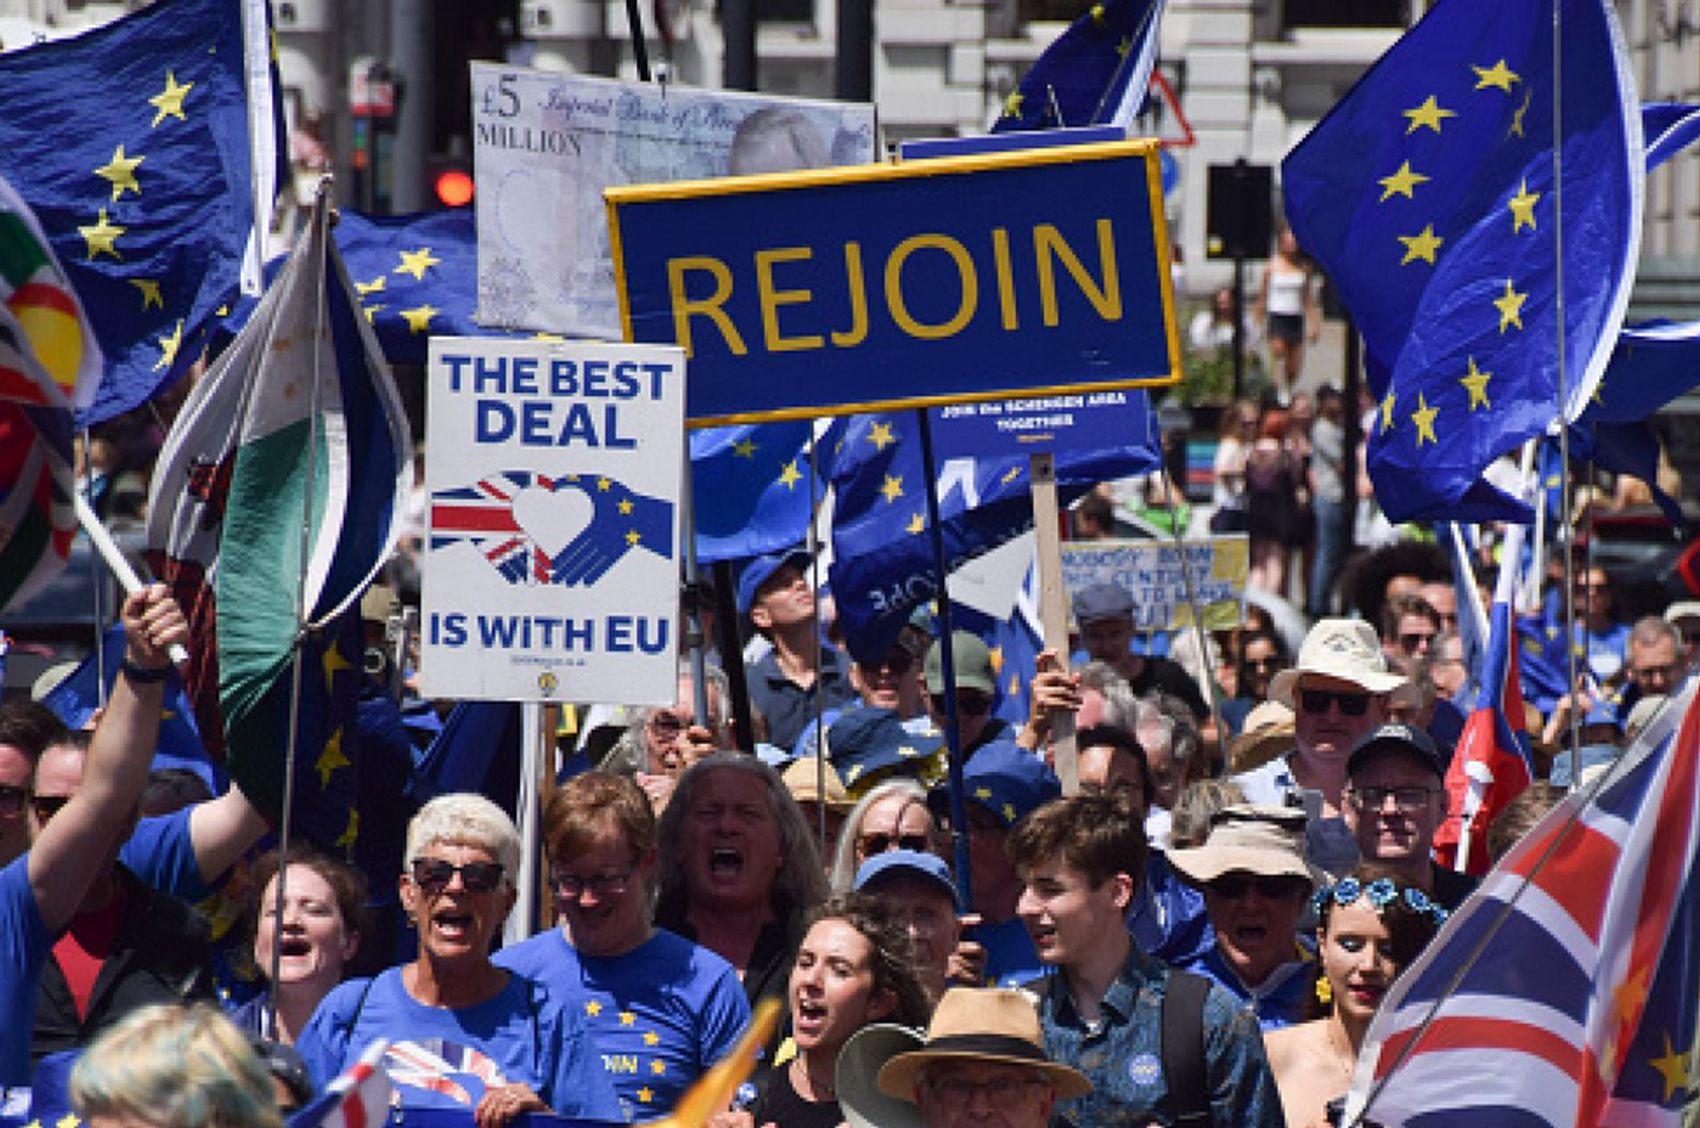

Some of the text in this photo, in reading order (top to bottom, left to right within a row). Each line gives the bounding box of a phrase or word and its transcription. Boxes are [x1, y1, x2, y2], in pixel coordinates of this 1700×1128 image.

[481, 74, 521, 117] £5
[477, 123, 581, 156] MILLION
[667, 218, 1123, 358] REJOIN
[441, 354, 673, 400] THE BEST
[475, 400, 637, 449] DEAL
[997, 413, 1073, 430] TOGETHER
[431, 613, 669, 655] IS WITH EU
